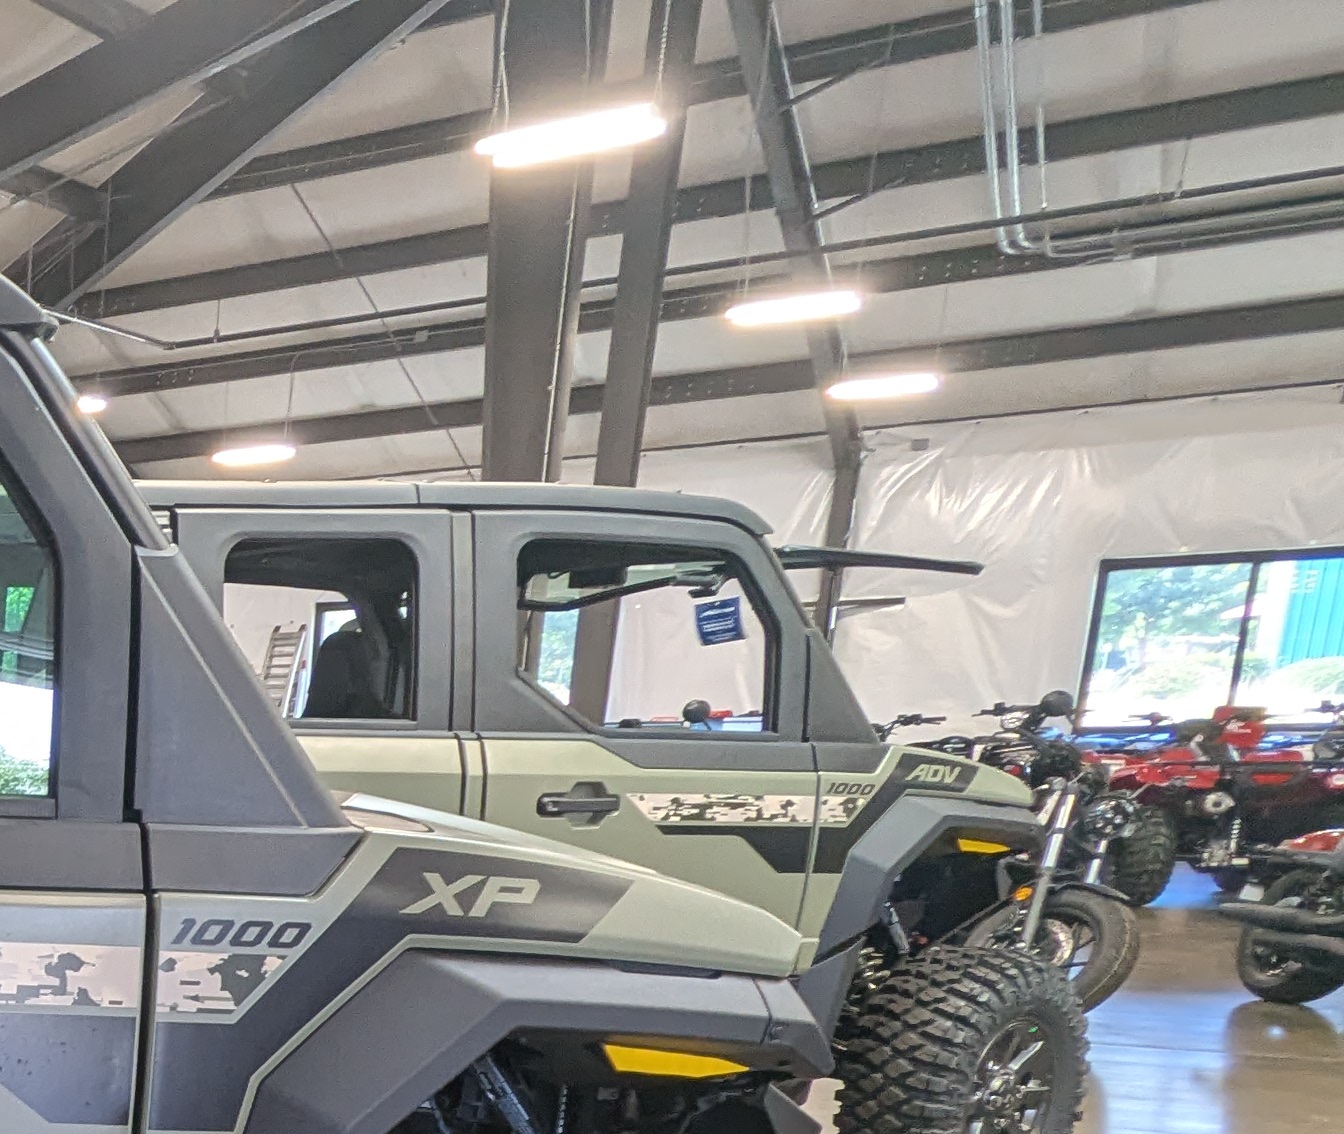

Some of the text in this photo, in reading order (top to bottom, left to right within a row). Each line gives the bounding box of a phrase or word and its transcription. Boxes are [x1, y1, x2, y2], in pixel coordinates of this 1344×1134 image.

[905, 763, 962, 784] ADV
[826, 782, 876, 796] 1000
[398, 871, 542, 918] XP
[169, 917, 313, 949] 1000
